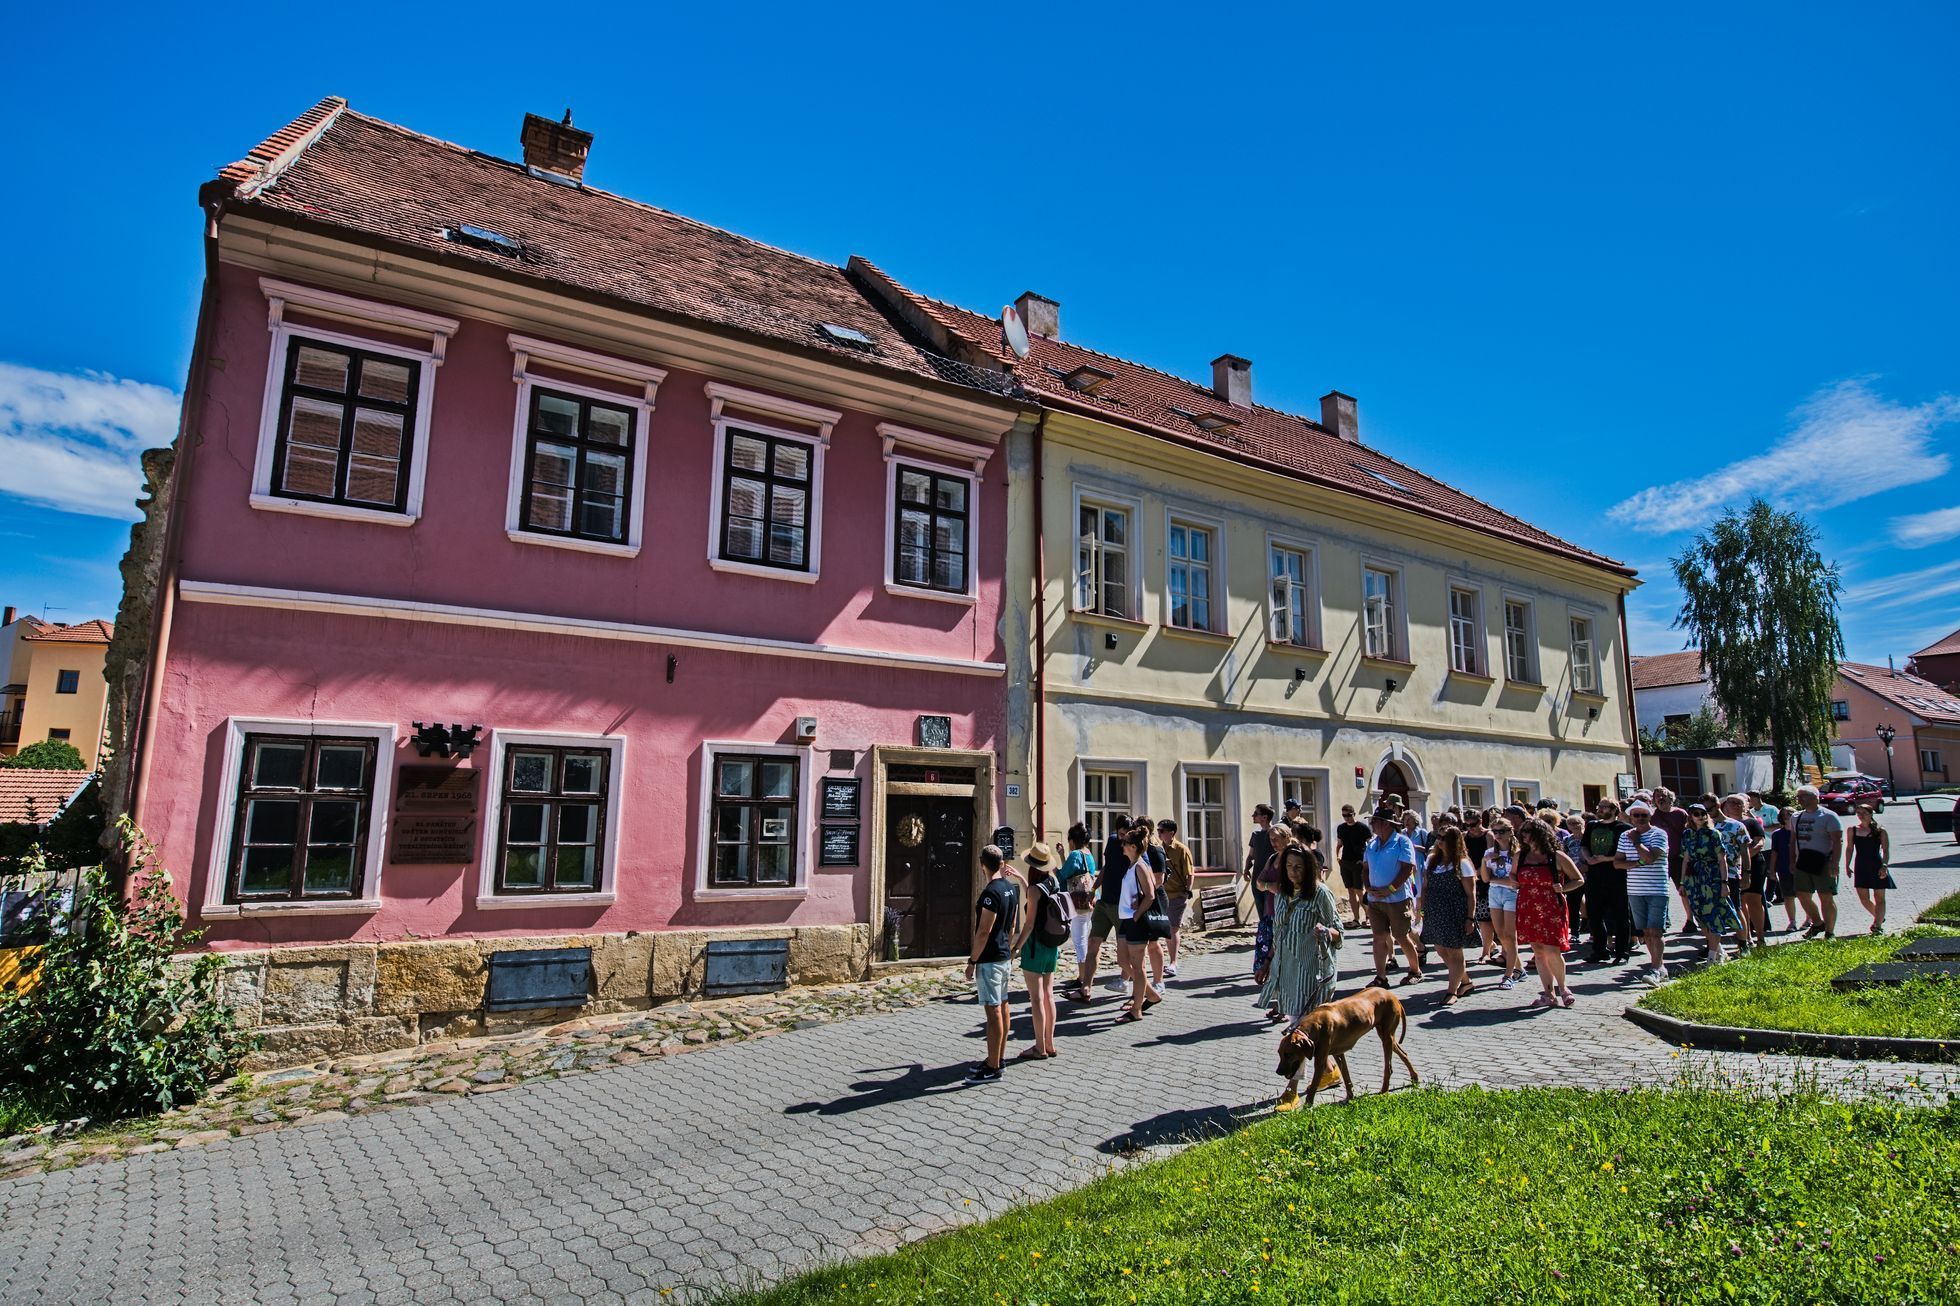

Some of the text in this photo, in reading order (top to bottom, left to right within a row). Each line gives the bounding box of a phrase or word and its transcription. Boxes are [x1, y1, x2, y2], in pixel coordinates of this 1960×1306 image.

[930, 773, 935, 782] 6
[1008, 786, 1018, 795] 382
[452, 791, 473, 800] 1968
